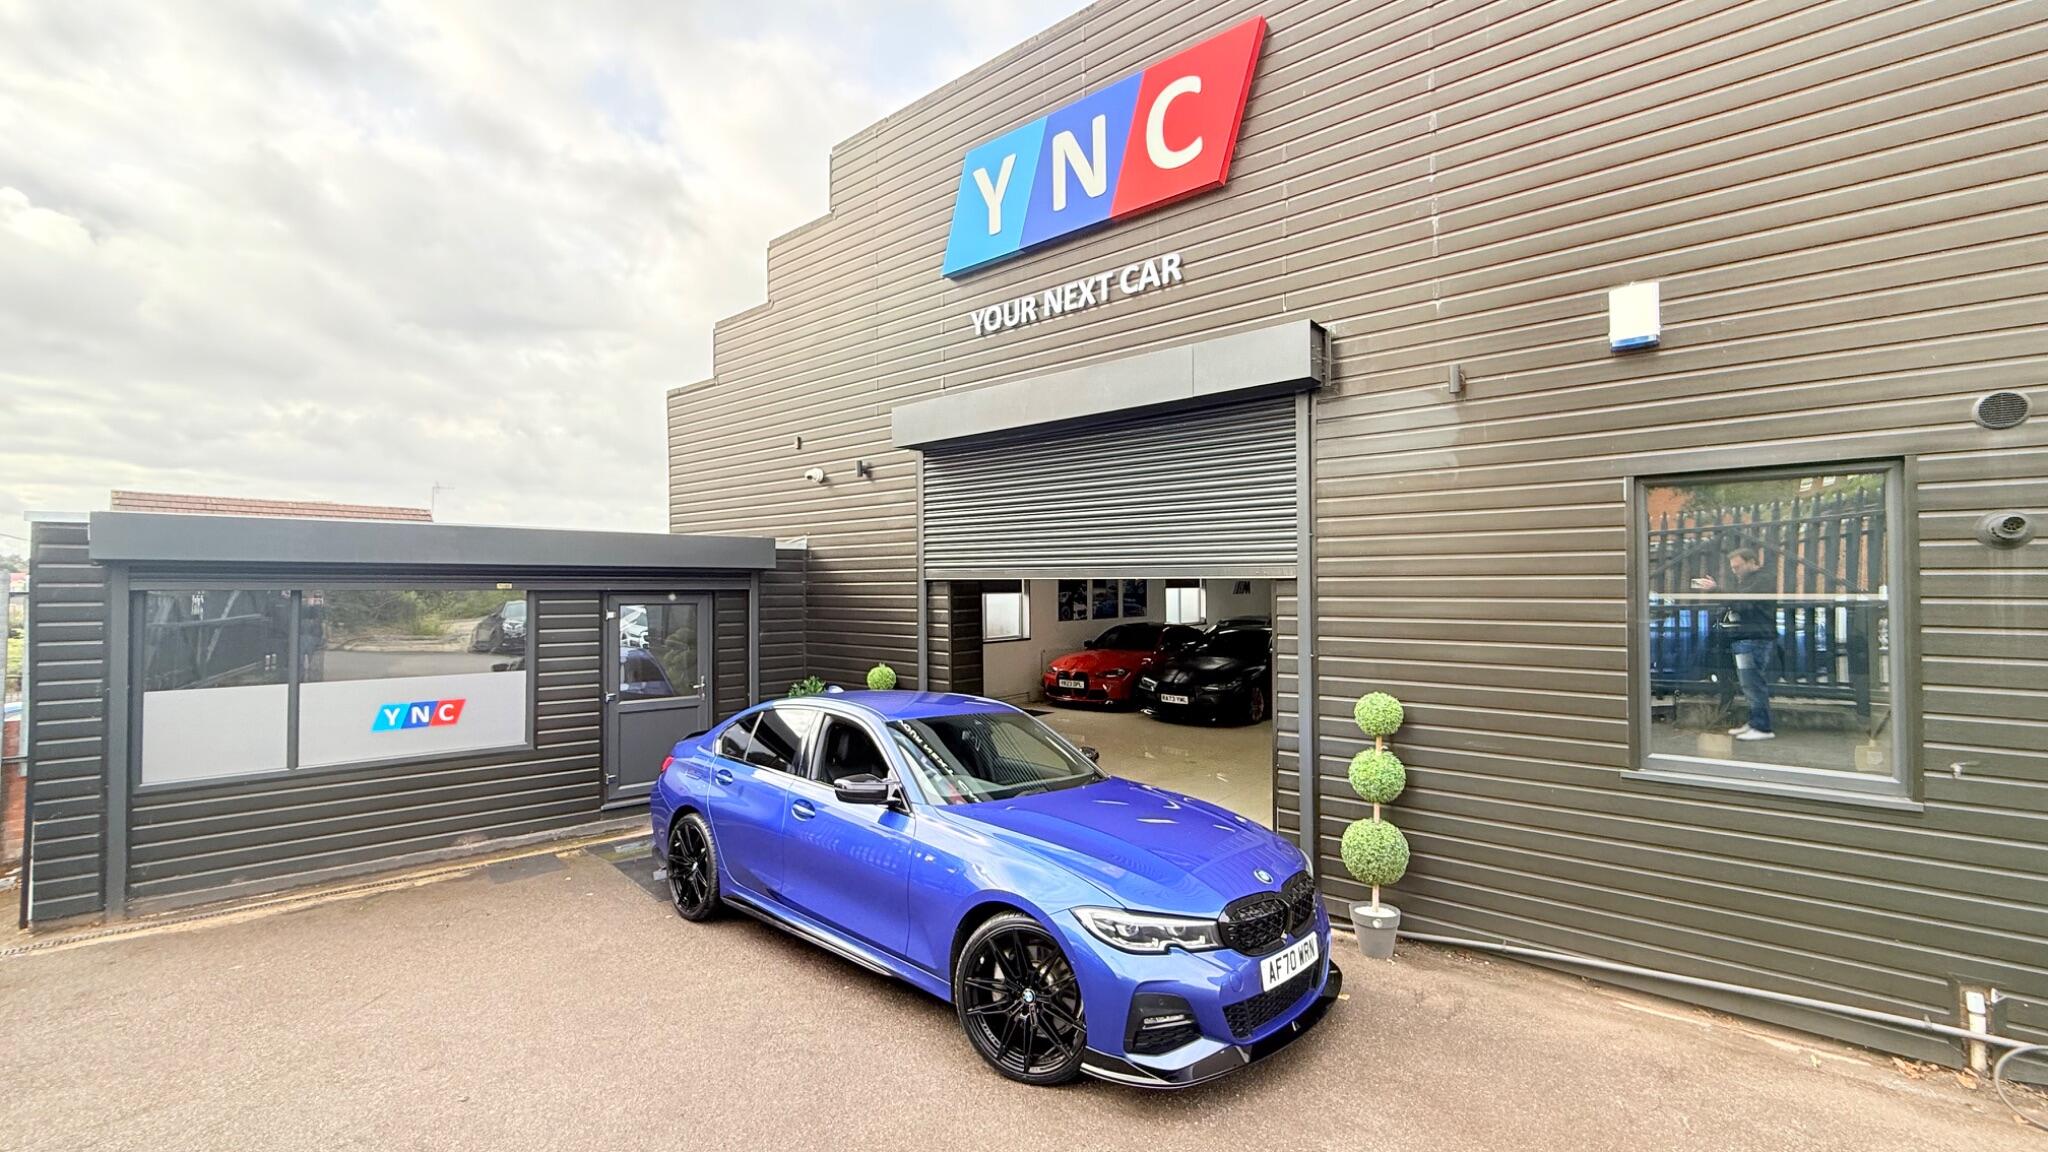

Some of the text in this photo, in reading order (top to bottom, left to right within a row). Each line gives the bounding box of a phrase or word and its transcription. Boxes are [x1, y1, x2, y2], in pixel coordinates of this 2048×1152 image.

[972, 75, 1203, 237] YNC
[970, 253, 1183, 336] YOUR NEXT CAR
[383, 703, 455, 727] YNC
[1269, 937, 1316, 984] AF70 WRN
